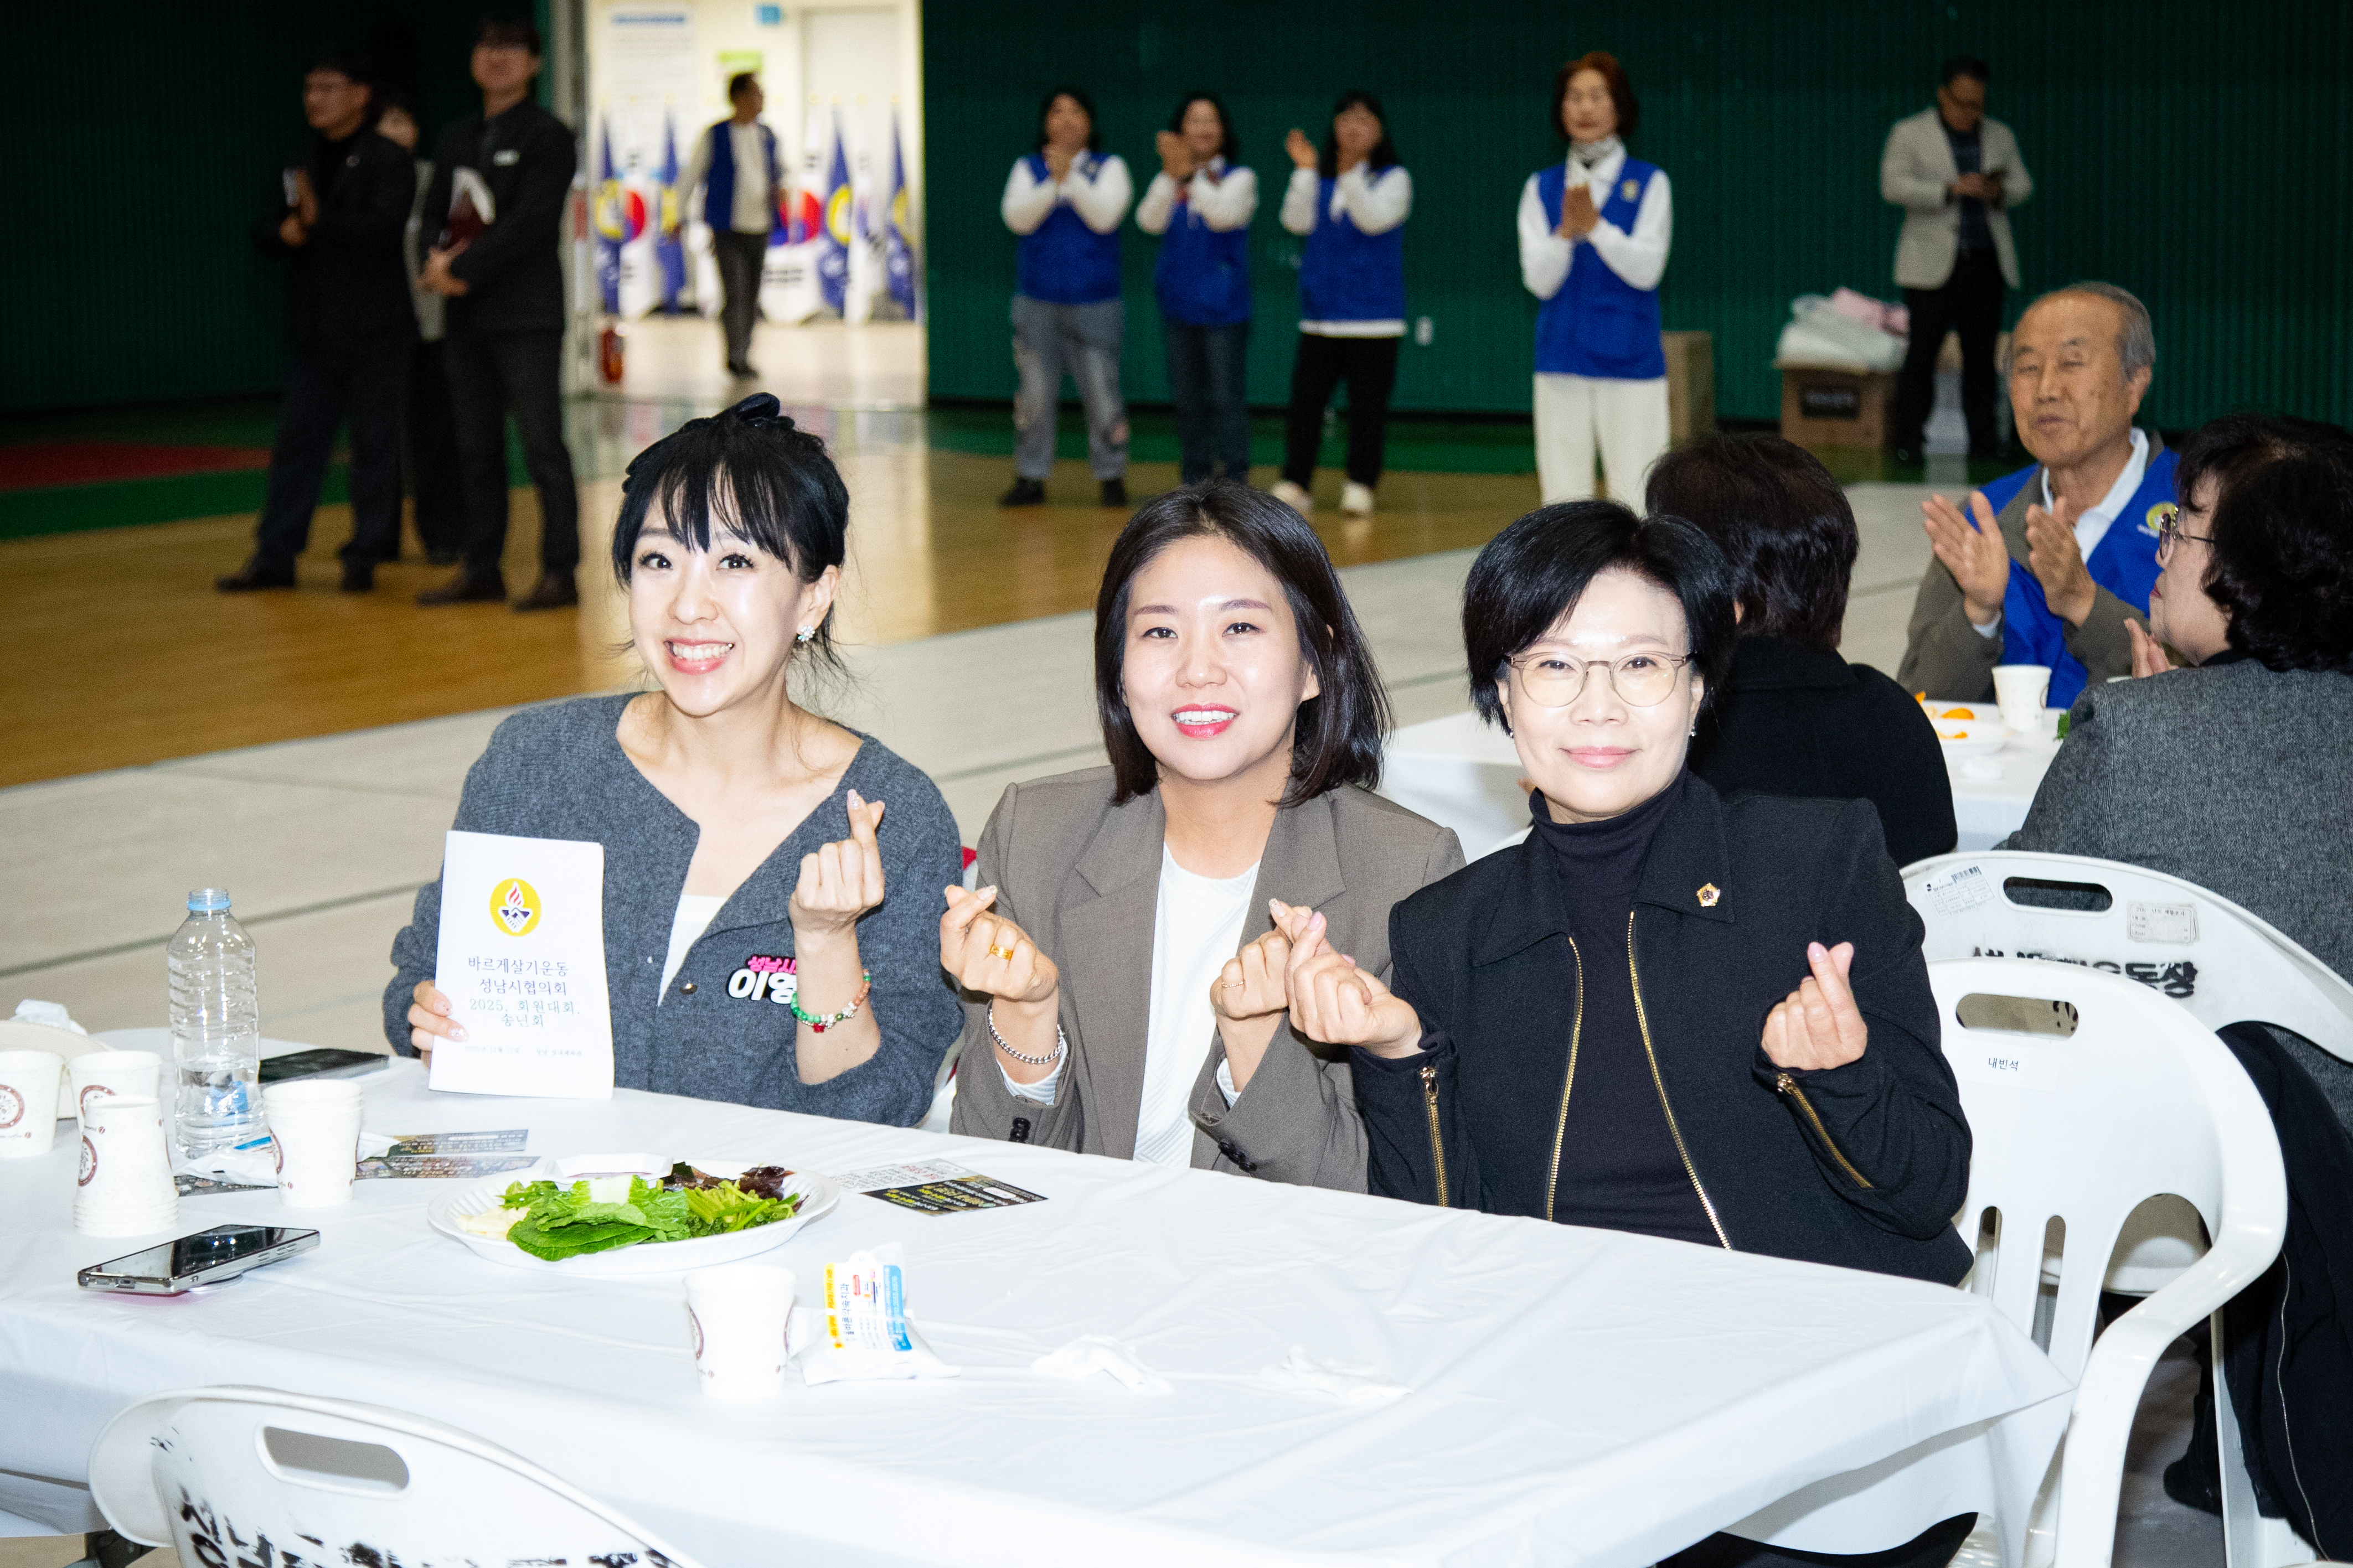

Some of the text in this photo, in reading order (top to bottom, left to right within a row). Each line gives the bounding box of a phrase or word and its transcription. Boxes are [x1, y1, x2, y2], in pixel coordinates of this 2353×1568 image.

[467, 956, 569, 977] 바르게살기운동
[747, 955, 797, 974] 성남시
[479, 978, 567, 996] 성남시협의회
[469, 998, 580, 1015] 2025. 회원대회.
[500, 1013, 544, 1028] 송년회
[1988, 1057, 2019, 1072] 내빈석
